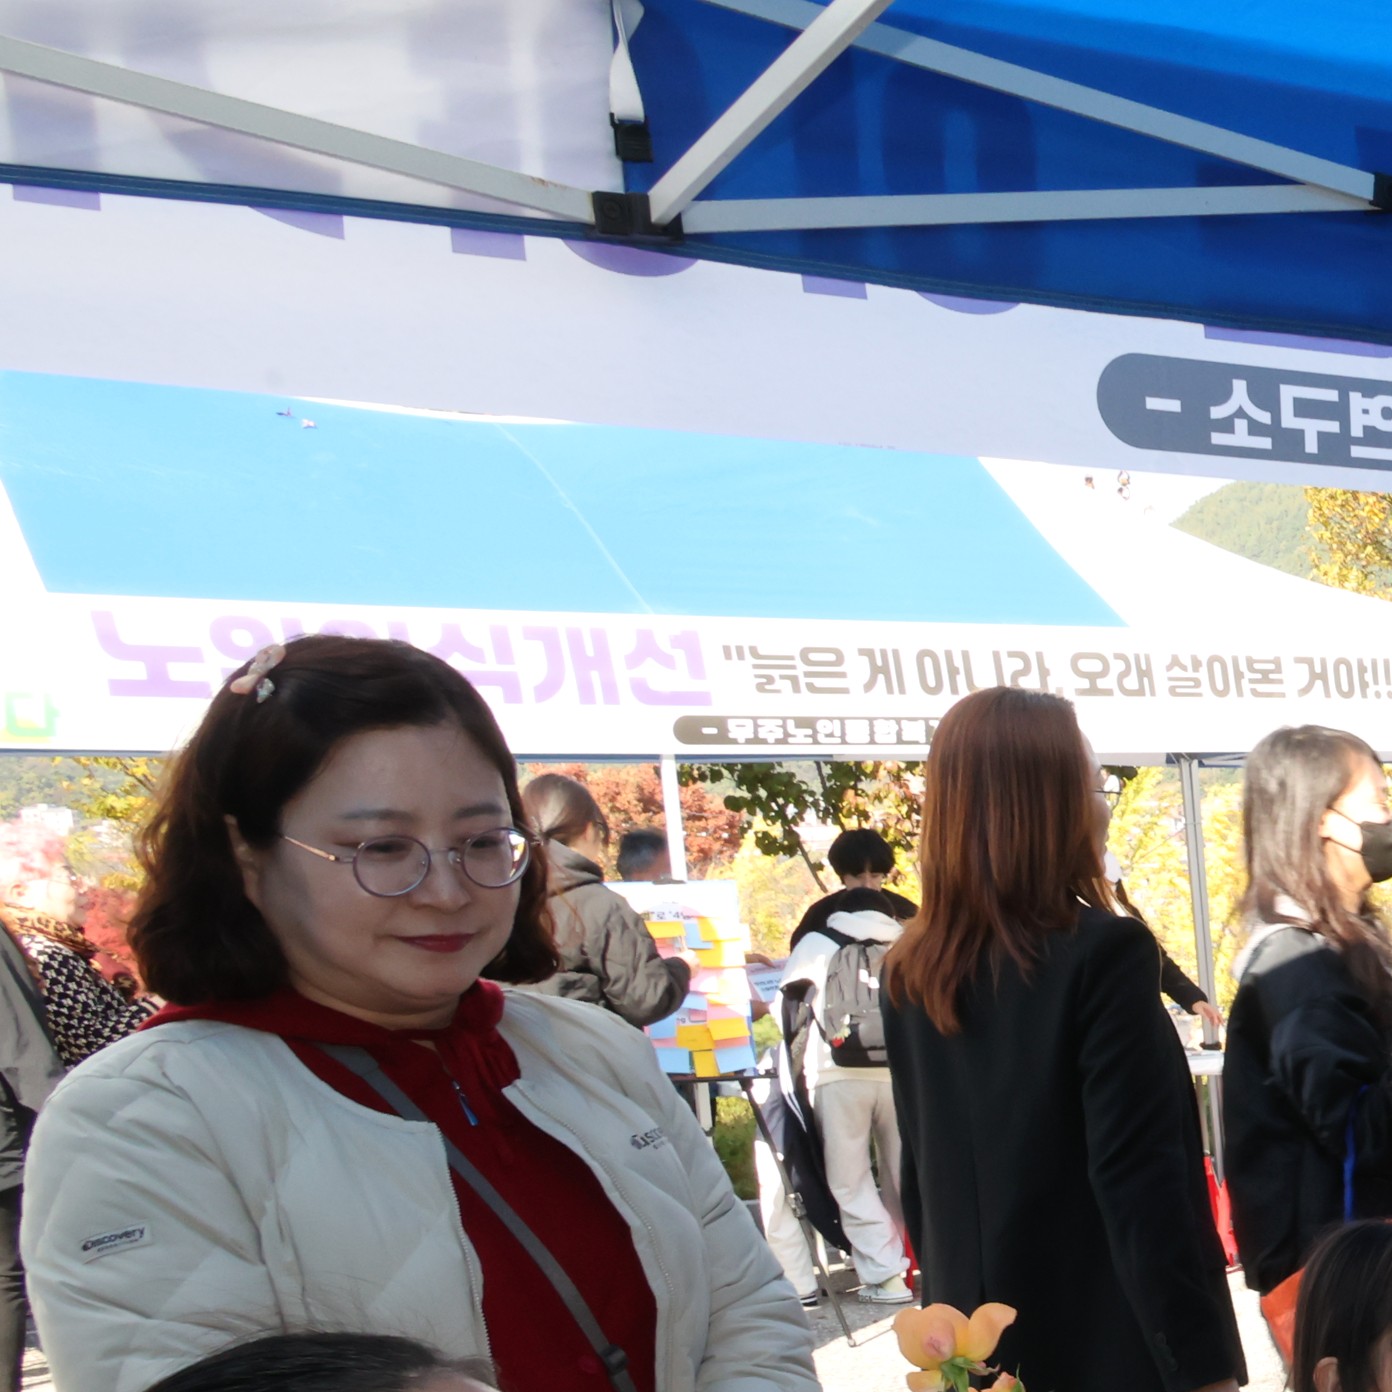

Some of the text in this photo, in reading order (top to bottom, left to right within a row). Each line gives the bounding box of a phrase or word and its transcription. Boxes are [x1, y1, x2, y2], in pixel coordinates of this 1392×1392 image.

[90, 610, 713, 706] 노식개선
[721, 644, 851, 695] "늙은
[857, 648, 907, 696] 게
[1070, 652, 1157, 698] 오래
[1165, 654, 1287, 699] 살아본
[727, 718, 937, 745] 무주노인통합복
